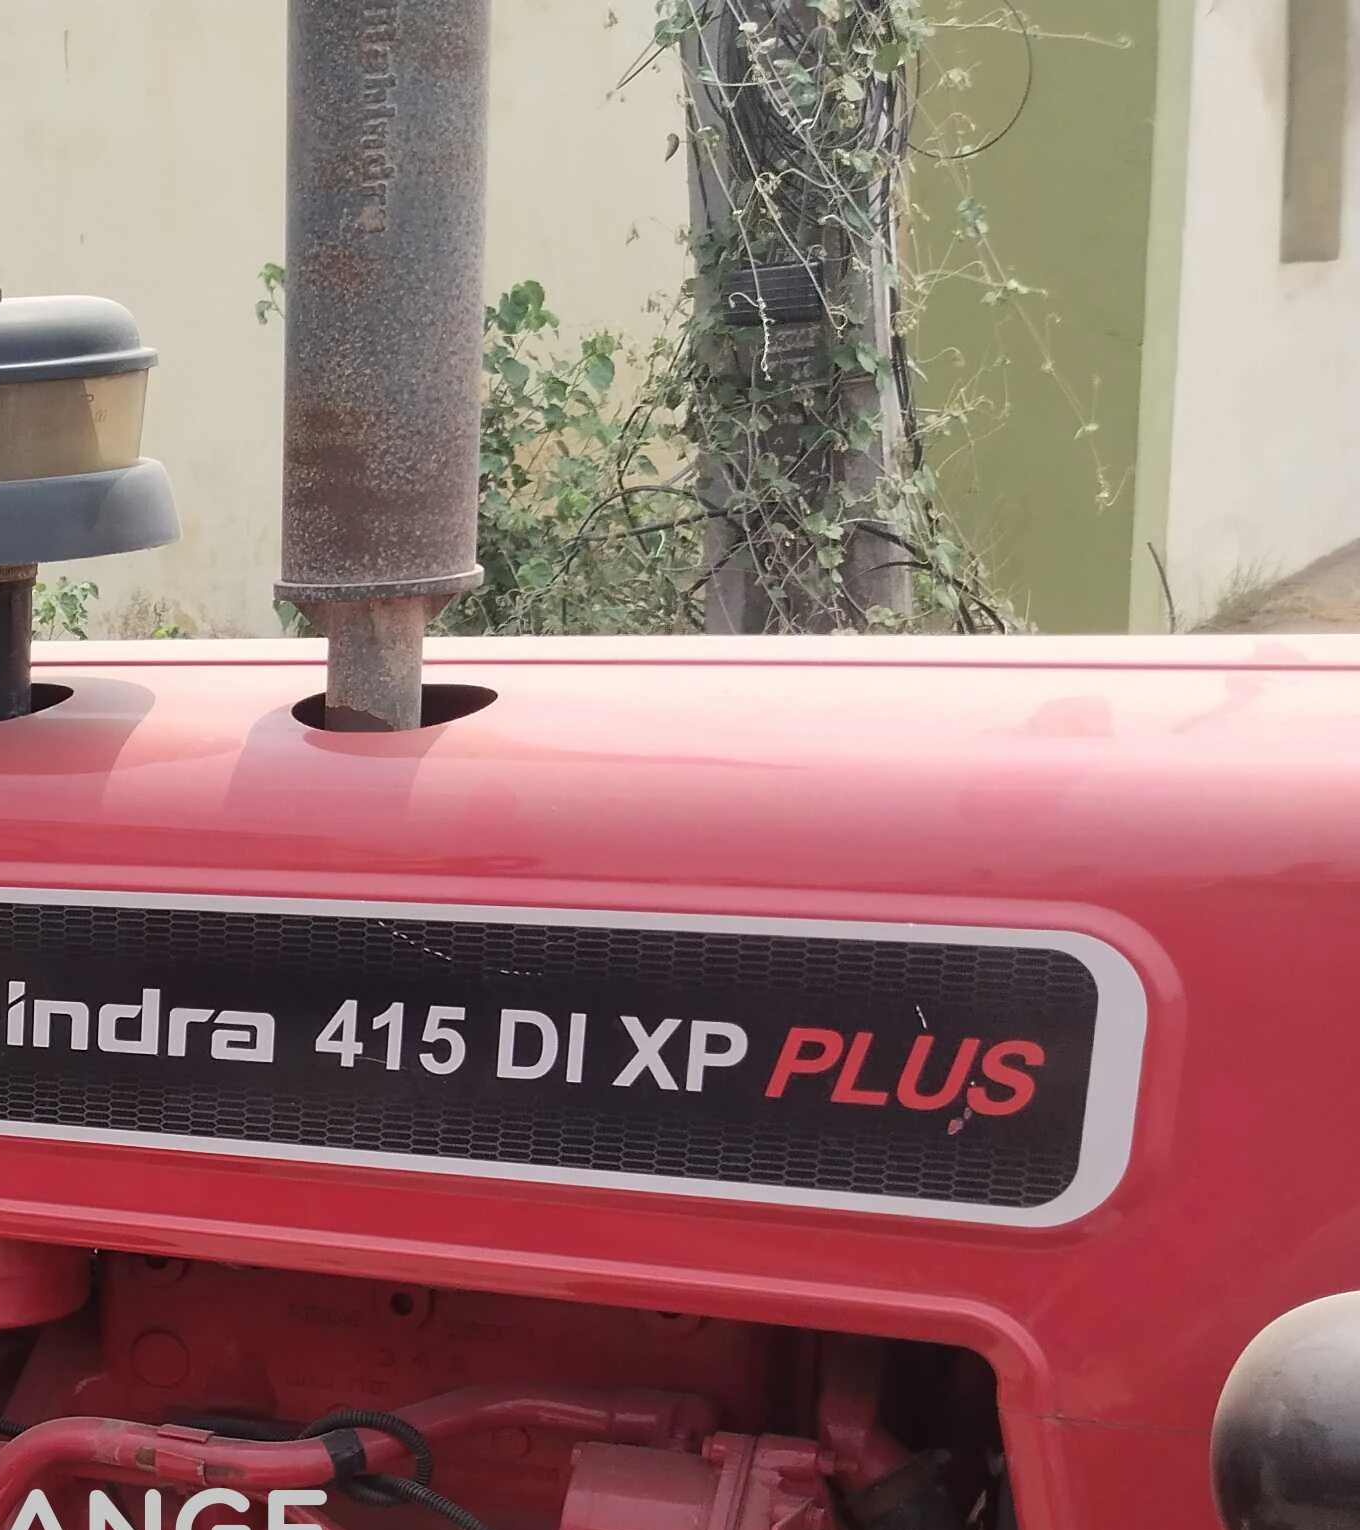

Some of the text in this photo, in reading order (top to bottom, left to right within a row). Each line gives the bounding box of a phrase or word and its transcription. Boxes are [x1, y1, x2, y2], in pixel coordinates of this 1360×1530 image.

[314, 998, 467, 1076] 415
[495, 1006, 588, 1084] DI
[611, 1014, 749, 1093] XP
[765, 1026, 1046, 1117] PLUS
